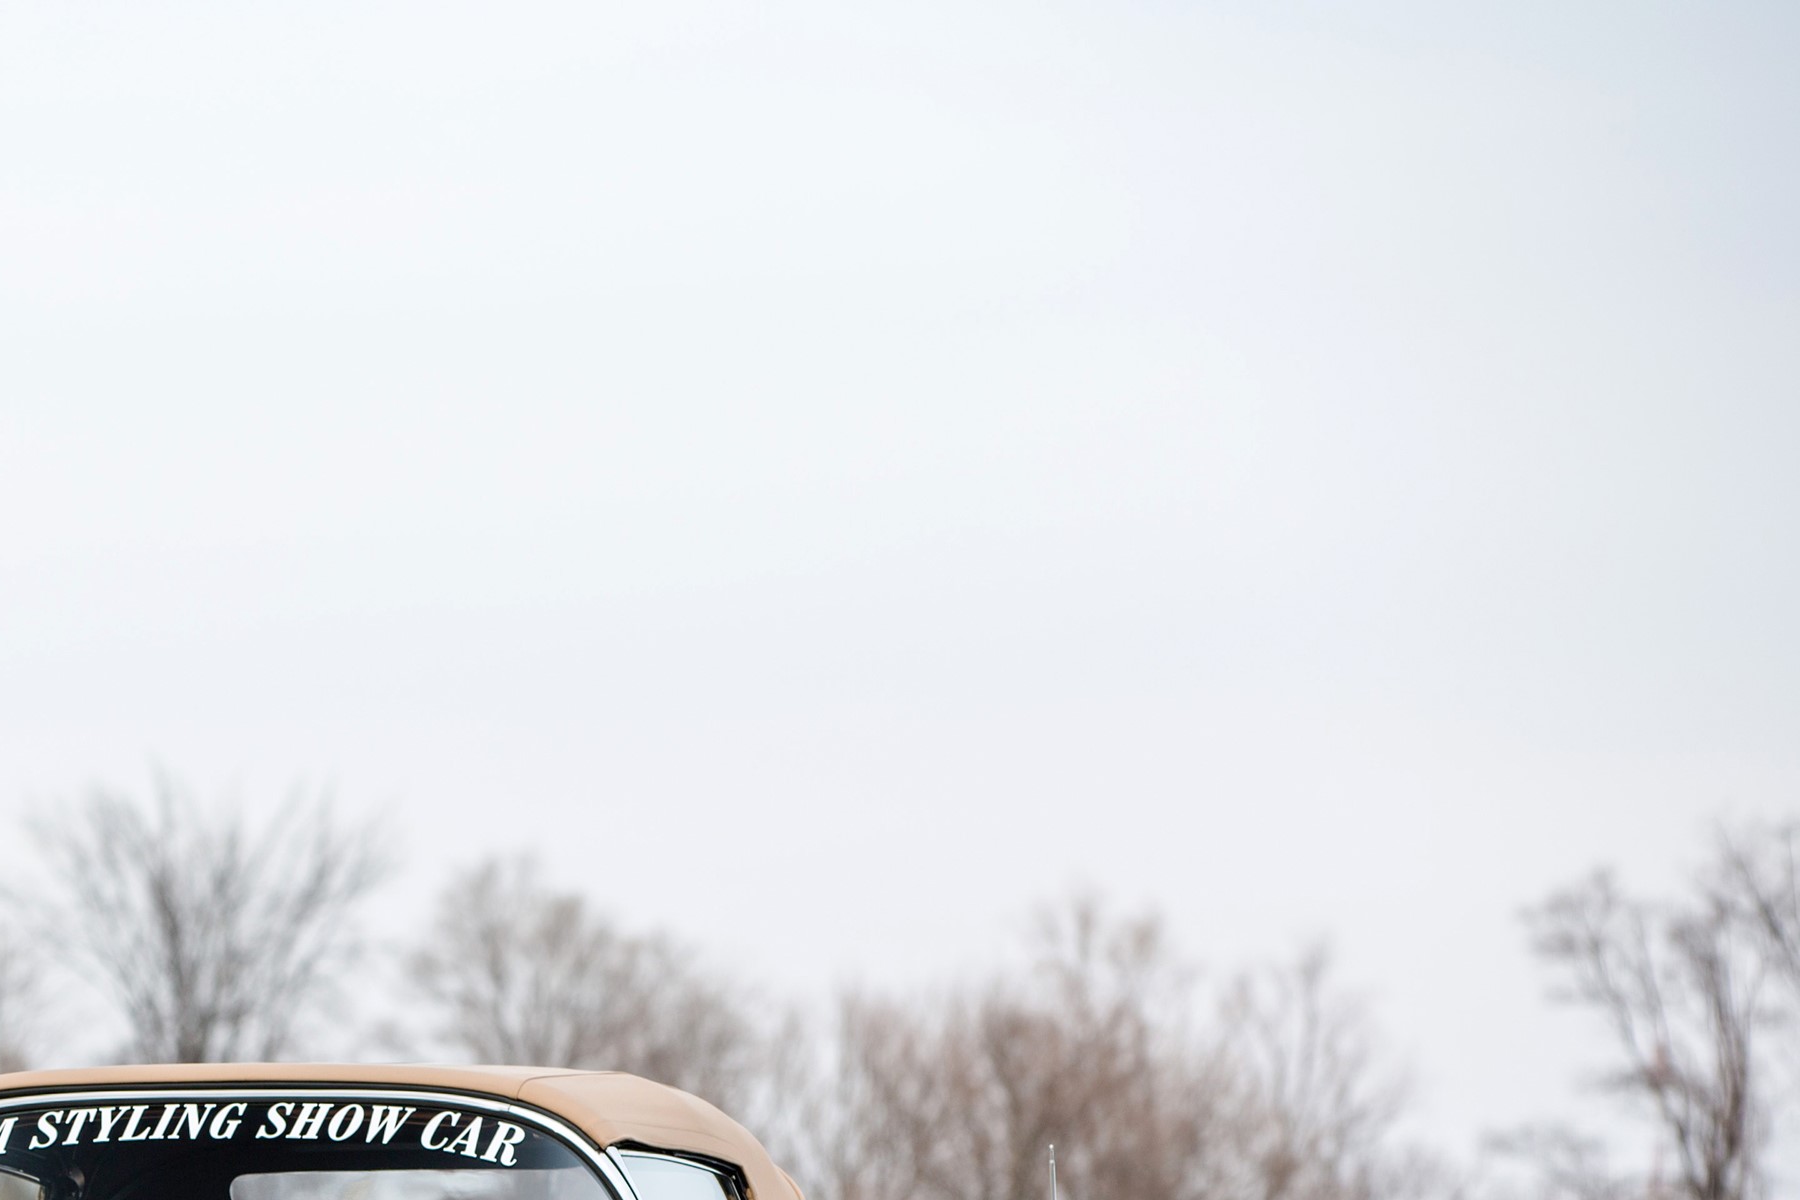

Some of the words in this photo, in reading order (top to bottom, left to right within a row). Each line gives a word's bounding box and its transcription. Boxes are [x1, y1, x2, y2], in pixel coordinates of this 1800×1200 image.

[28, 1103, 247, 1151] STYLING
[256, 1101, 416, 1142] SHOW
[420, 1110, 527, 1167] CAR
